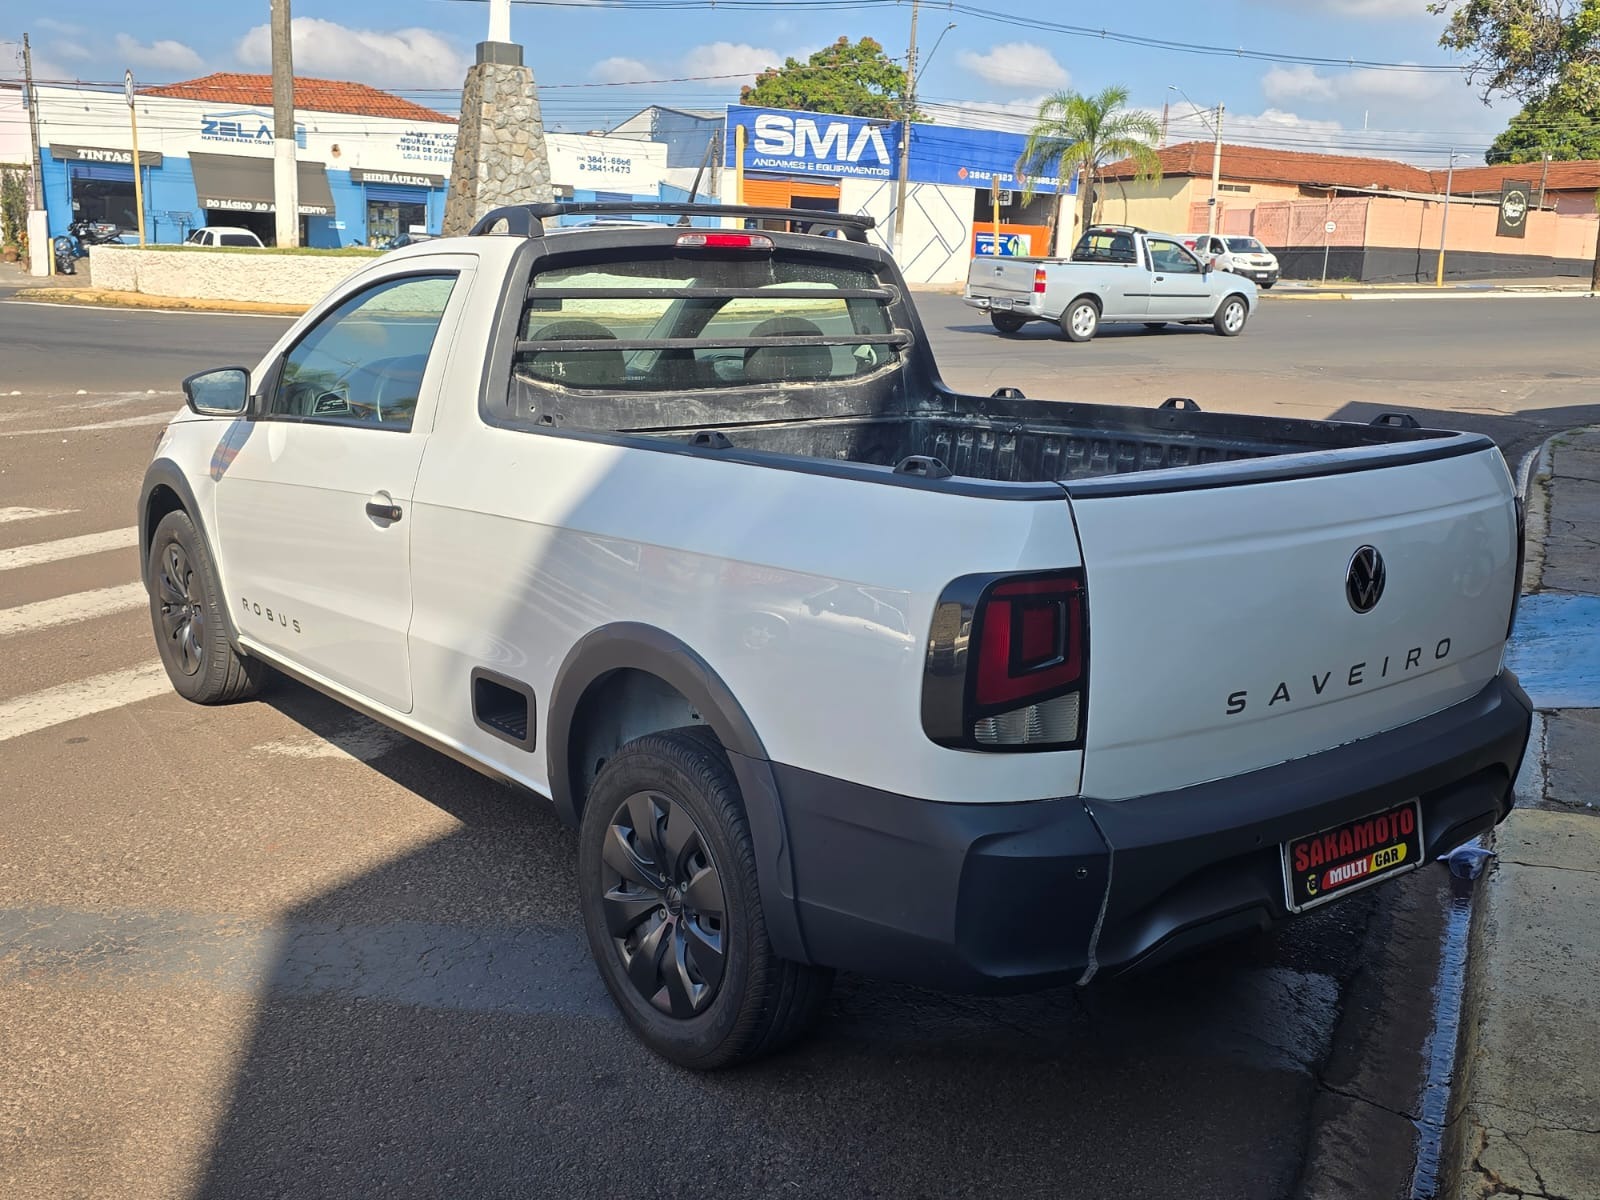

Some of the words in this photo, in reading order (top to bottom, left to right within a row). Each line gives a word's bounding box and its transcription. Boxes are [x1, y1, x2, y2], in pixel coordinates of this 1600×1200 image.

[77, 149, 131, 163] TINTAS
[754, 114, 890, 164] SMA
[362, 172, 432, 186] HIDRÁULICA
[753, 158, 806, 170] ANDAIMES
[808, 162, 815, 171] E
[816, 164, 890, 177] EQUIPAMENTOS
[206, 199, 219, 208] DO
[220, 199, 252, 210] BÁSICO
[255, 202, 268, 211] AO
[242, 597, 301, 634] ROBUS
[1226, 638, 1451, 714] SAVEIRO
[1295, 808, 1414, 872] SAKAMOTO
[1329, 858, 1367, 885] MULTI
[1374, 847, 1399, 867] CAR
